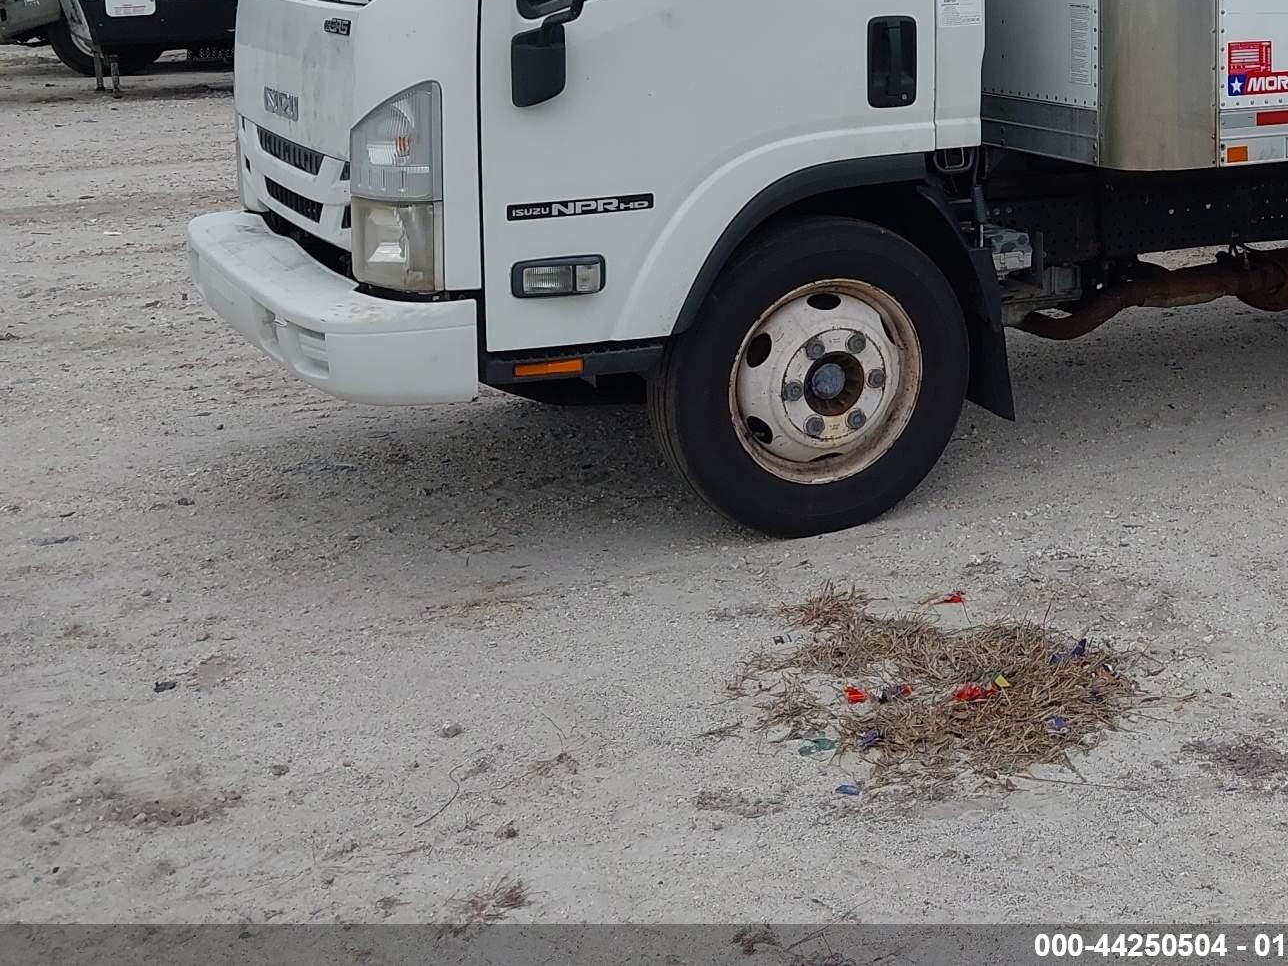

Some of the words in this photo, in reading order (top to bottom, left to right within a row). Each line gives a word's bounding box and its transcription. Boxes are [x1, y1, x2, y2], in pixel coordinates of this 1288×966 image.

[512, 207, 549, 217] ISUZU
[551, 198, 619, 216] NPR
[619, 200, 649, 210] HD
